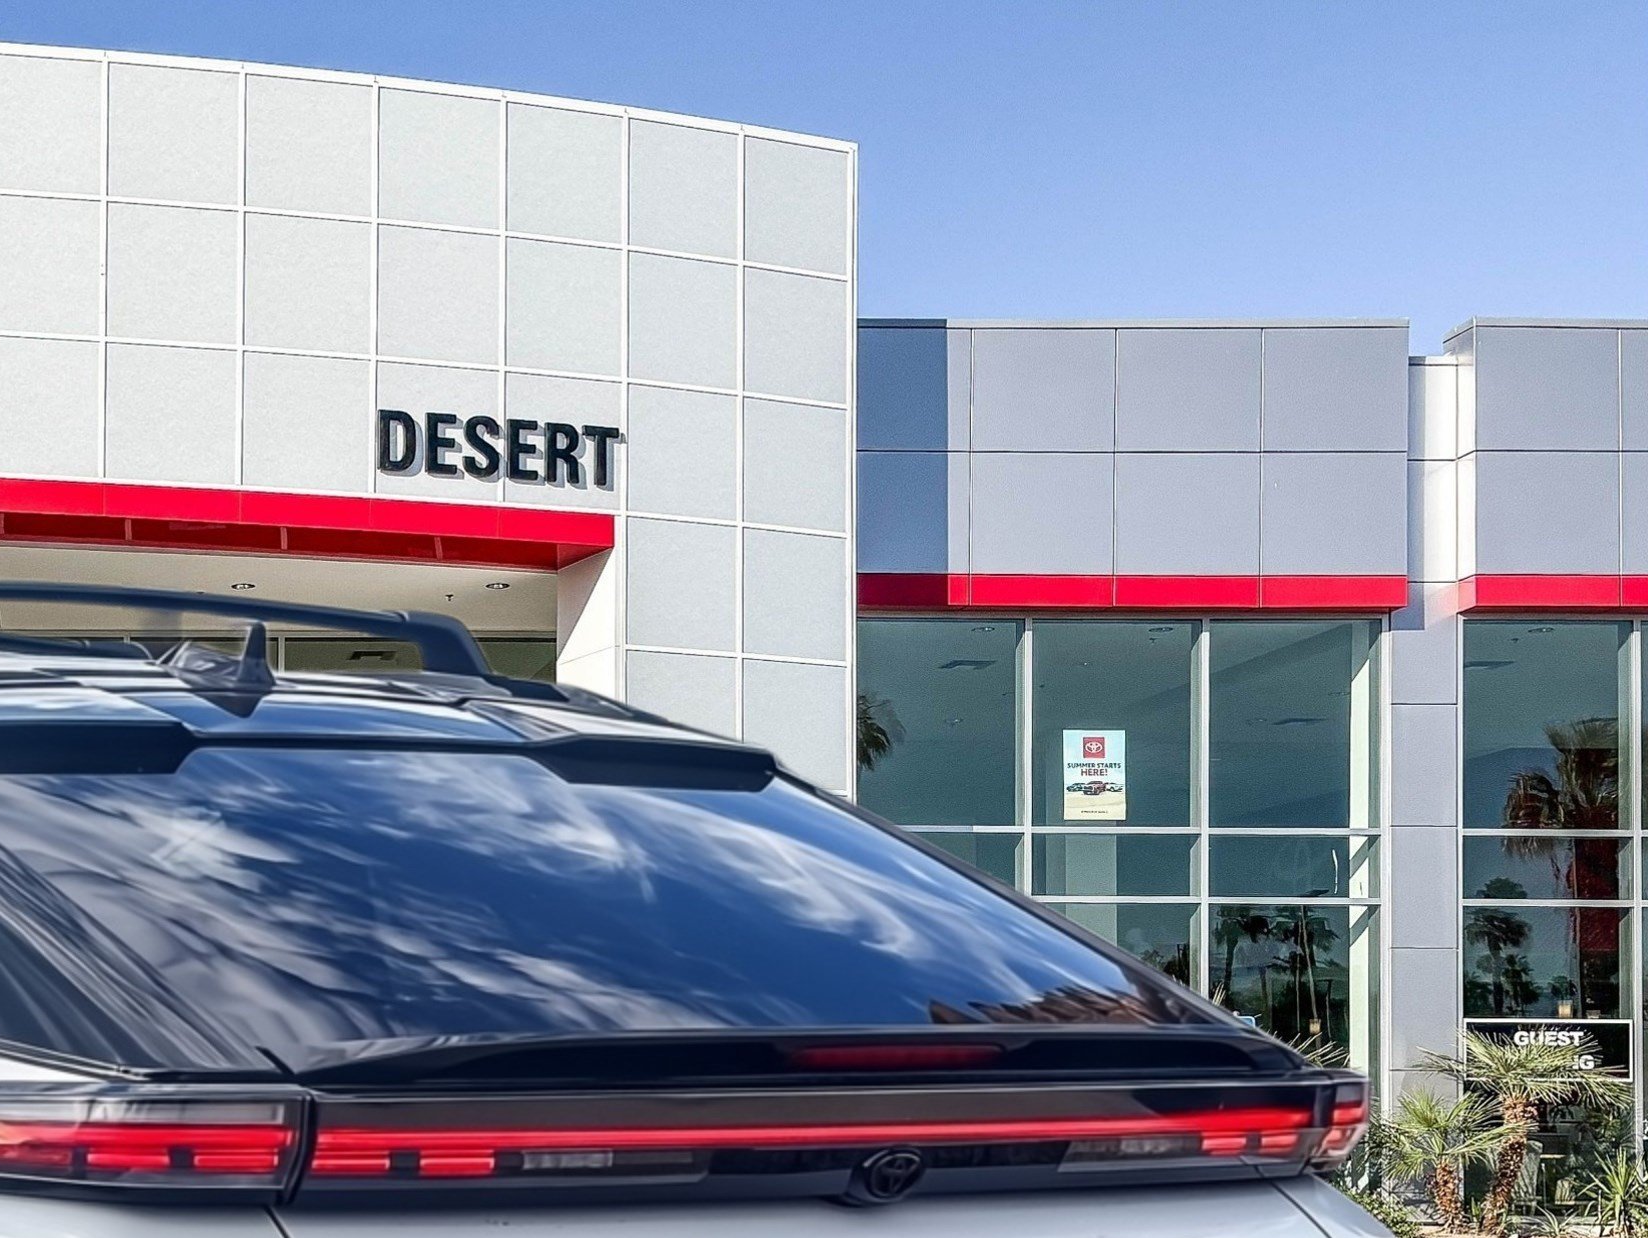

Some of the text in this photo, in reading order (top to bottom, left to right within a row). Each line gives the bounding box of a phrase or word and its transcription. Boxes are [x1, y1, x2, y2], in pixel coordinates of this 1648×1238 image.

[377, 409, 620, 487] DESERT
[1080, 768, 1108, 777] HERE!
[1513, 1030, 1585, 1047] GUEST
